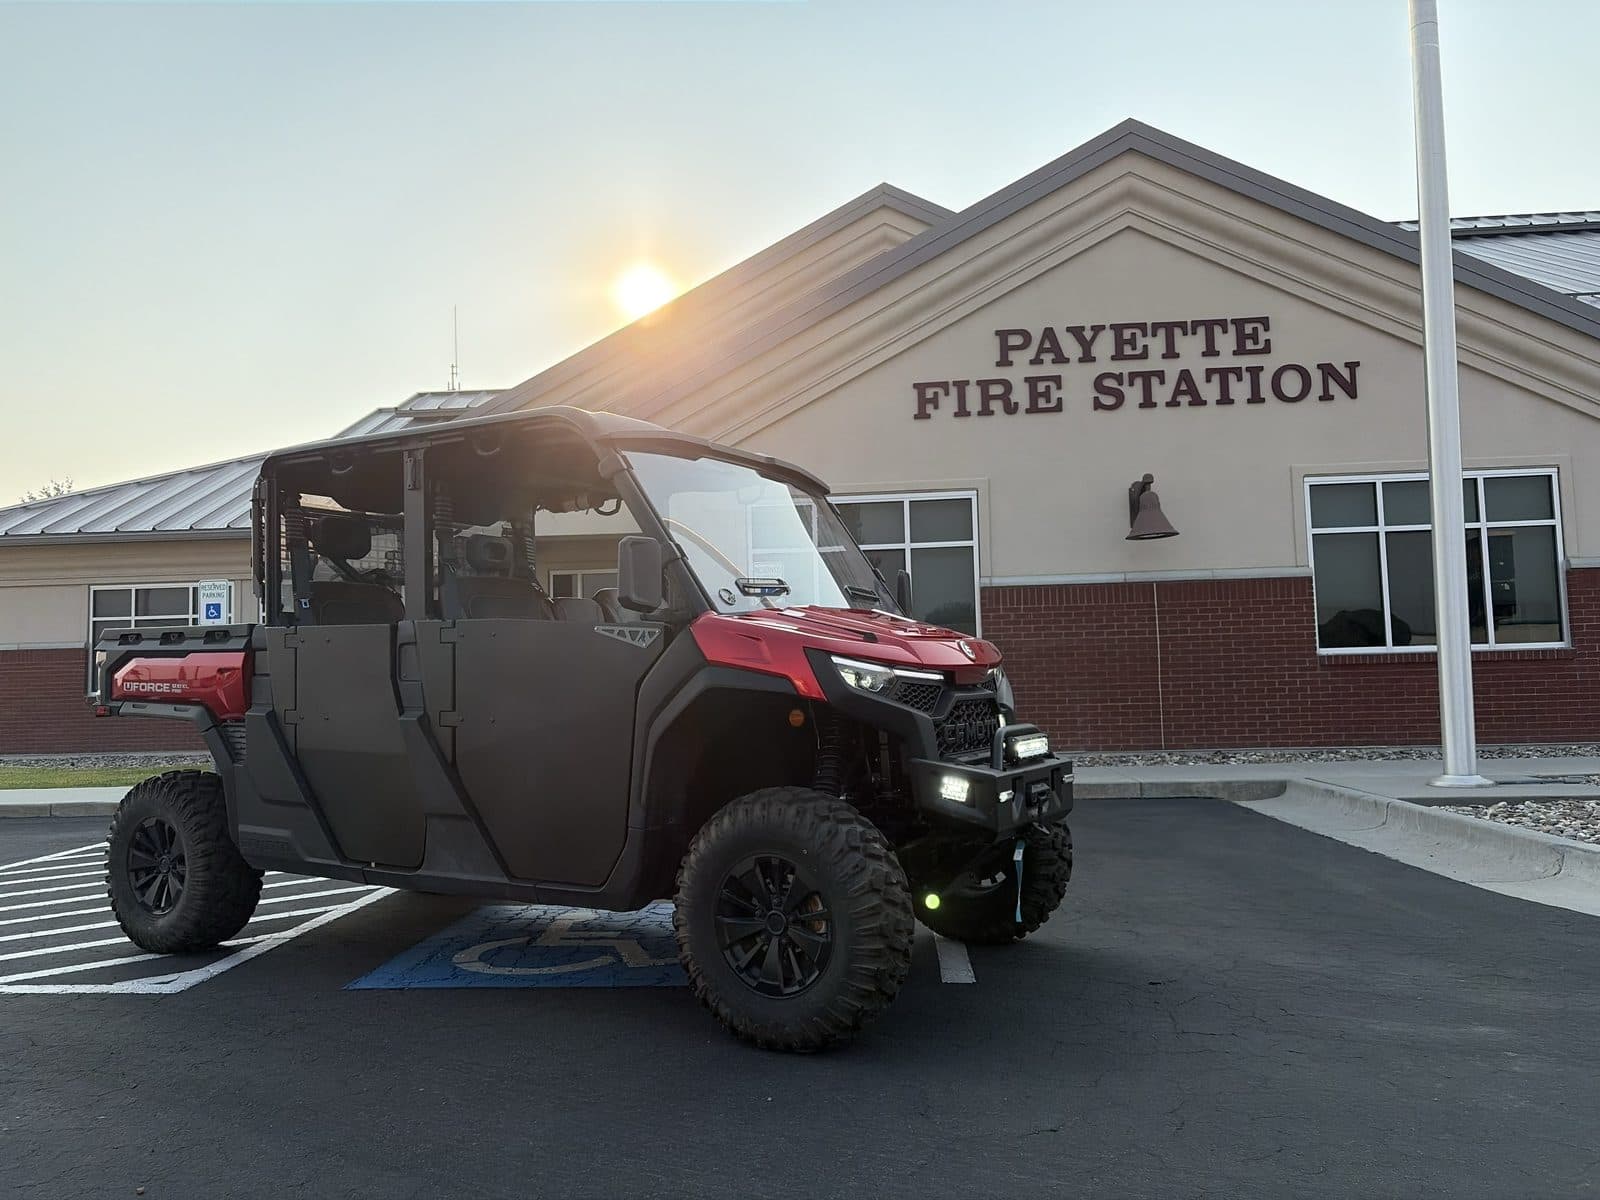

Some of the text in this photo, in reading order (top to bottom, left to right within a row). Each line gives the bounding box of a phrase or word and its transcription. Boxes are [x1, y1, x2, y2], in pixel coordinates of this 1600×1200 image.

[994, 316, 1271, 368] PAYETTE
[913, 361, 1360, 420] FIRE STATION
[123, 681, 171, 693] UFORCE
